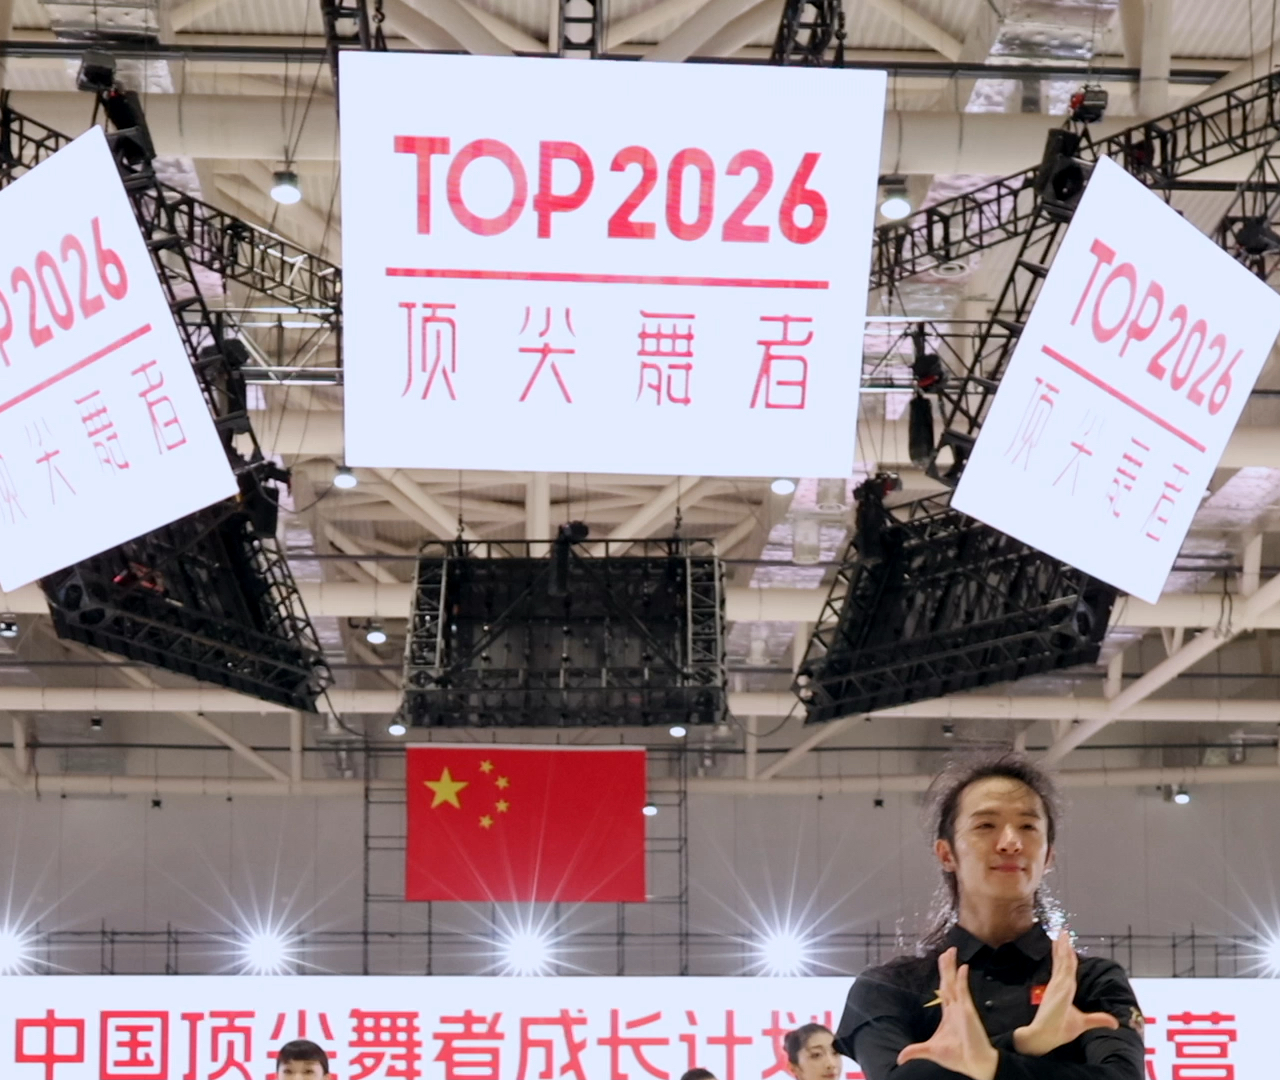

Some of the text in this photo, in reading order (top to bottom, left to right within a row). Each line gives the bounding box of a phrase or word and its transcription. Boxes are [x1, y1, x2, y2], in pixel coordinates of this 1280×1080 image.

[394, 135, 828, 244] TOP2026
[398, 302, 814, 410] 顶尖舞者
[1070, 237, 1244, 416] TOP2026
